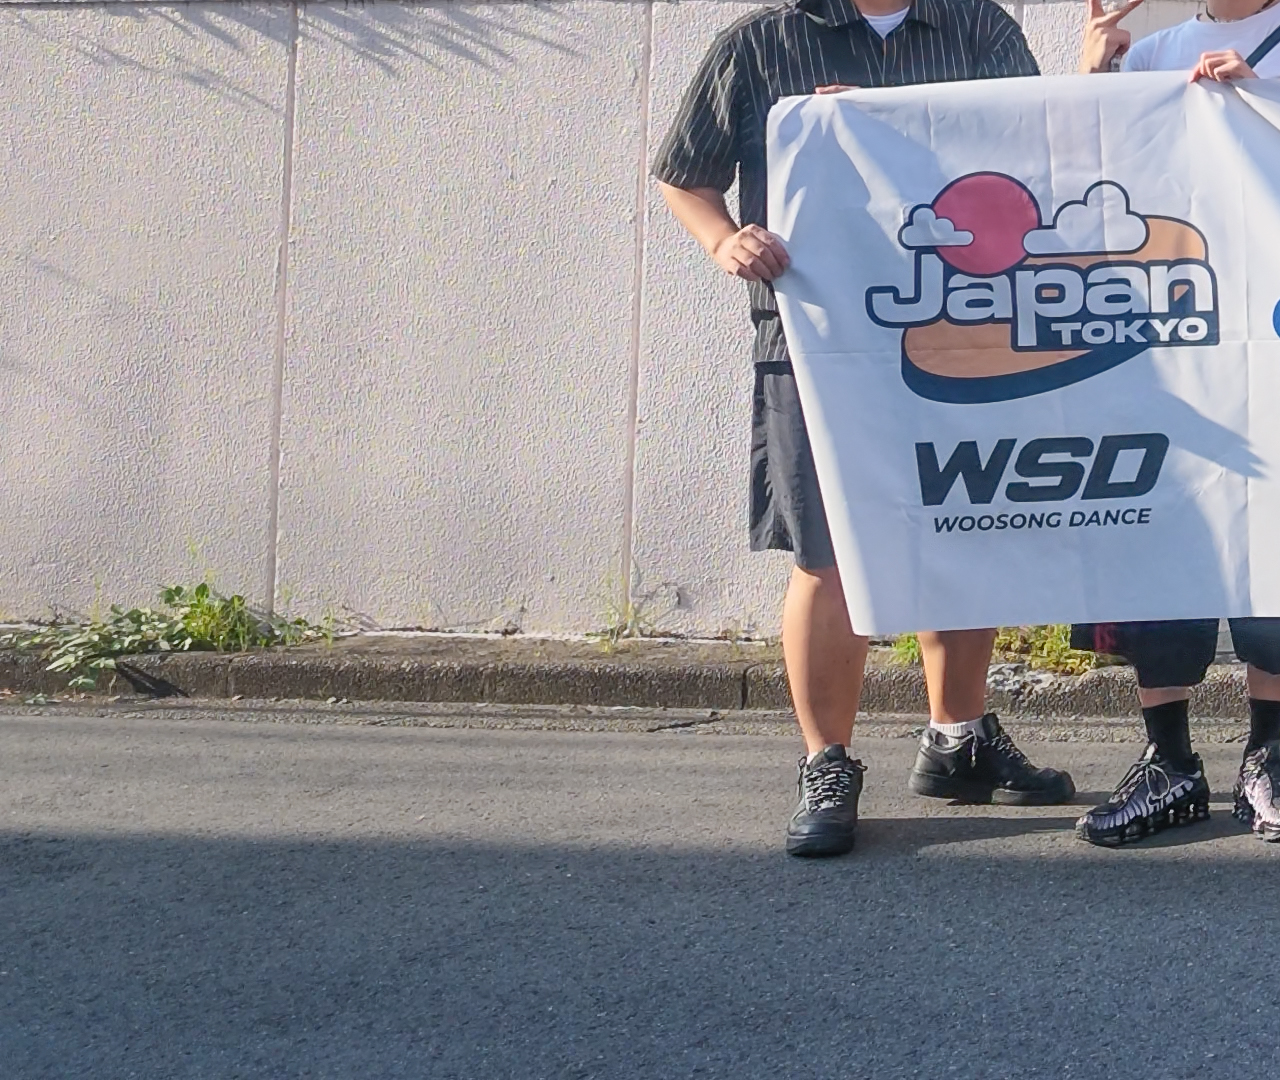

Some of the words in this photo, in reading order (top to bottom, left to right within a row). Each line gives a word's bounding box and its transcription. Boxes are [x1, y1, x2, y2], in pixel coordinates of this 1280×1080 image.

[867, 247, 1217, 350] Japan
[1051, 316, 1209, 345] TOKYO
[914, 432, 1170, 507] WSD
[932, 511, 1062, 534] WOOSONG
[1069, 507, 1152, 528] DANCE
